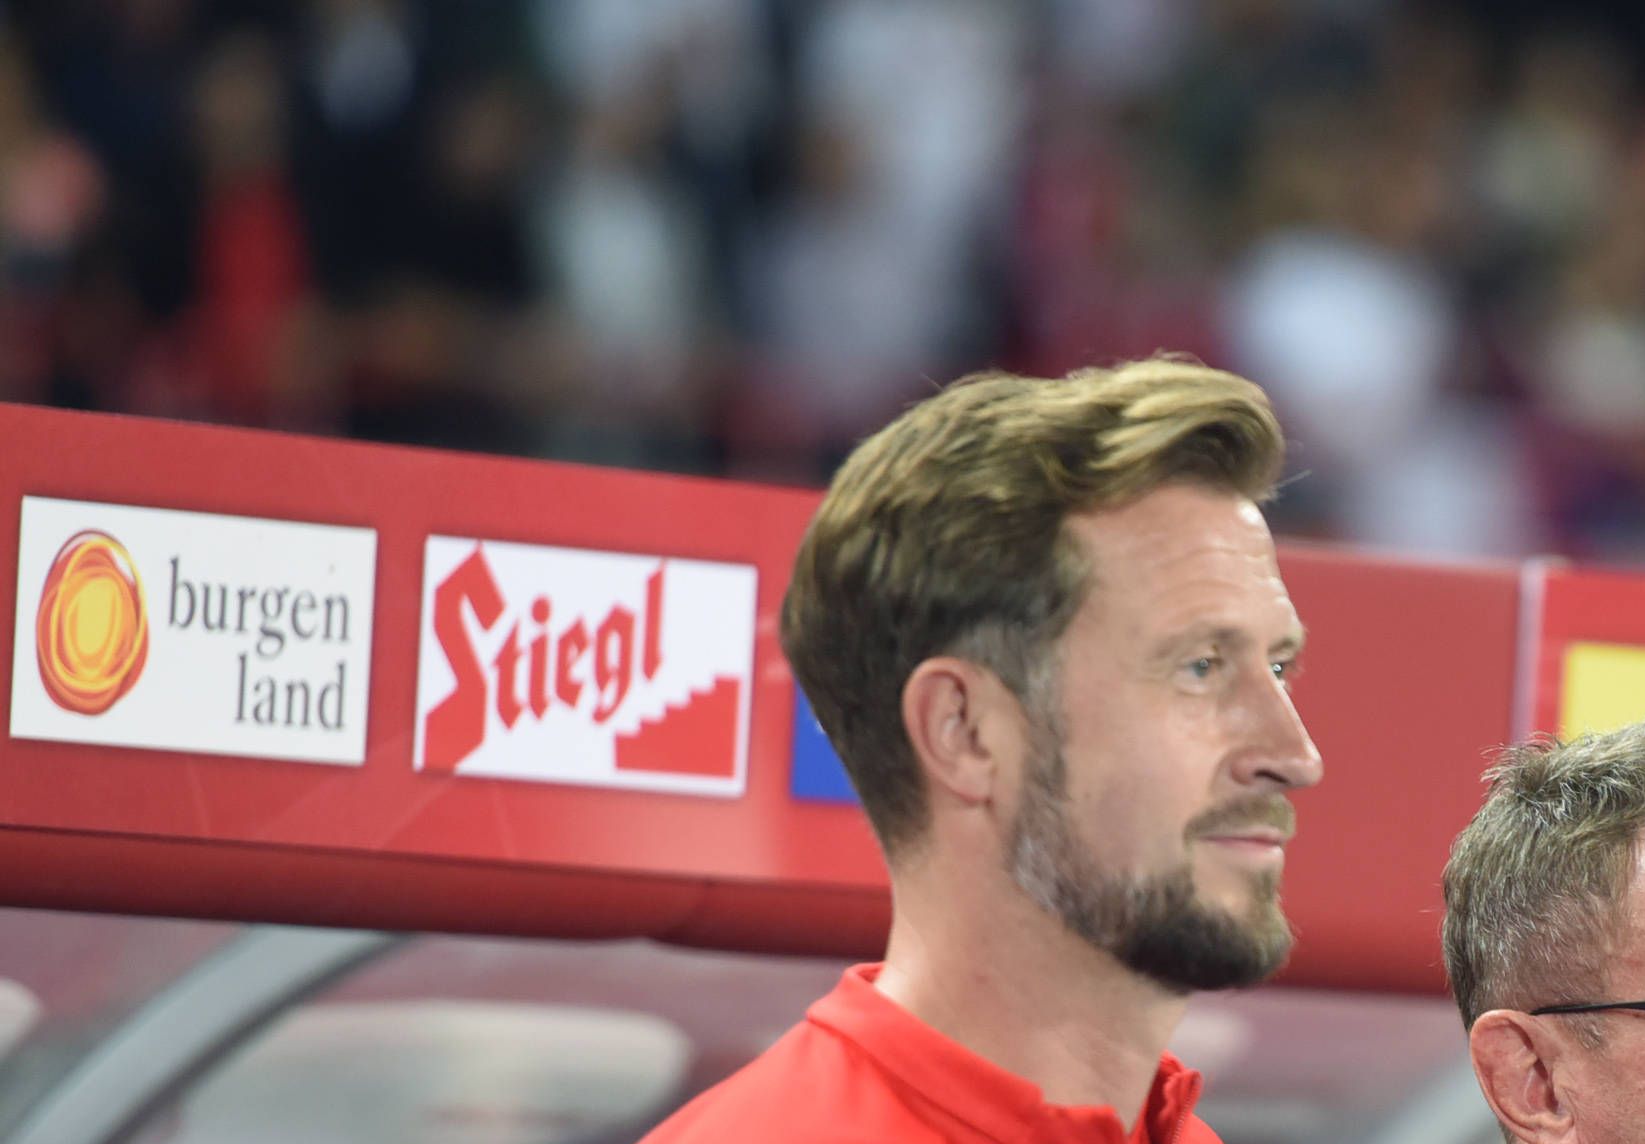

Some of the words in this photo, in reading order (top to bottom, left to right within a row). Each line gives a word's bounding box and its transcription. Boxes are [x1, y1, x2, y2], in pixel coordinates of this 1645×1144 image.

[169, 556, 351, 659] burgen
[424, 541, 665, 774] Stiegl
[234, 654, 347, 731] land
